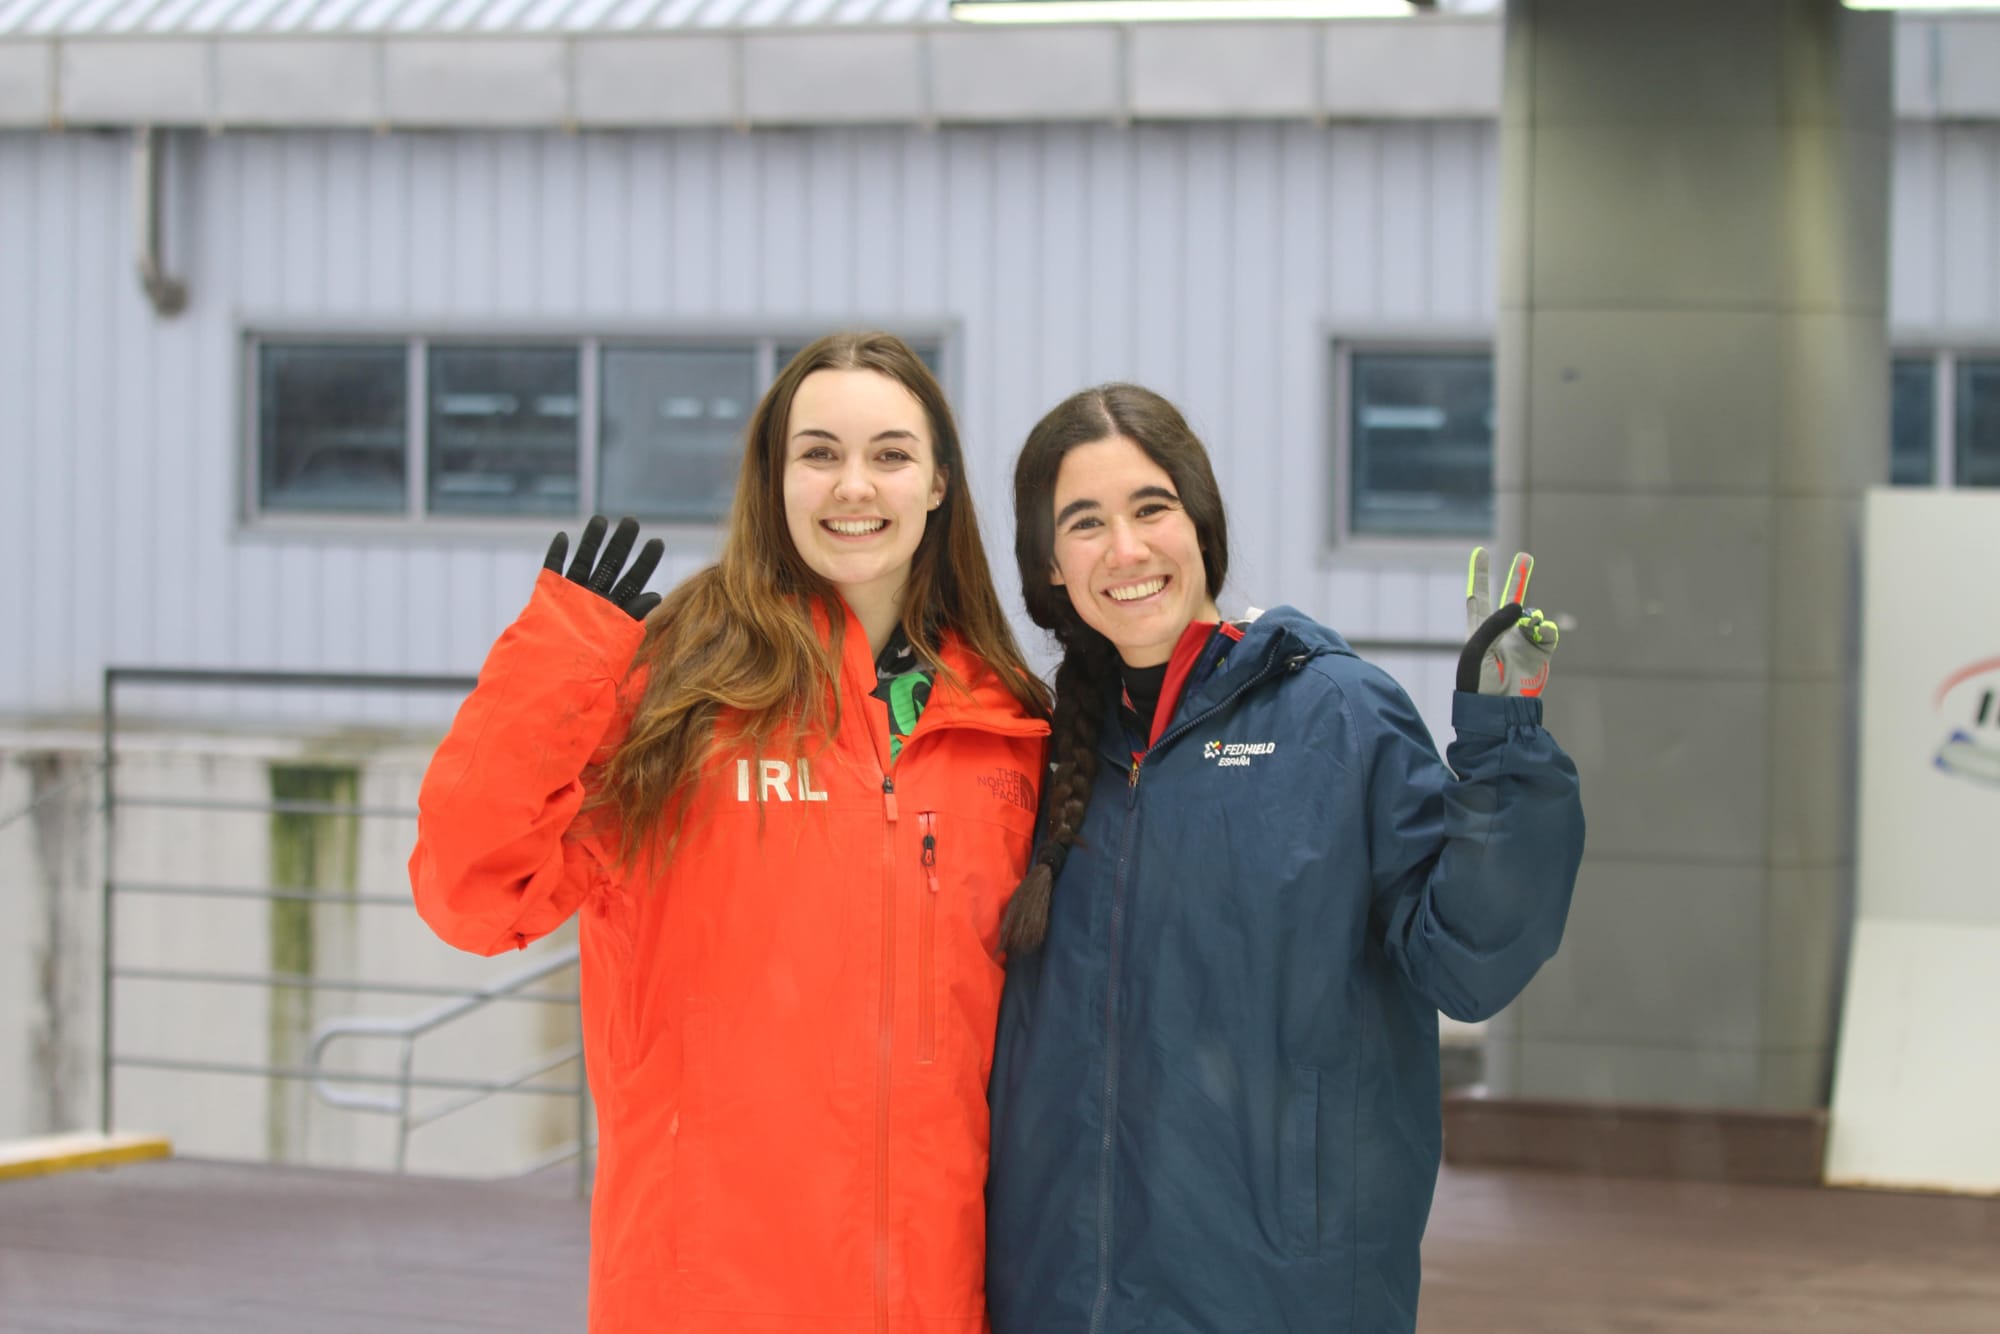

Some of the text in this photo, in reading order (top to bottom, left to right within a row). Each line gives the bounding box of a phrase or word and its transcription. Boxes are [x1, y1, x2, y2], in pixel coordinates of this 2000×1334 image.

[1218, 755, 1250, 767] ESPAÑA
[737, 759, 828, 802] IRL
[995, 767, 1019, 780] THE
[976, 775, 1019, 793] NORTH
[991, 787, 1019, 806] FACE
